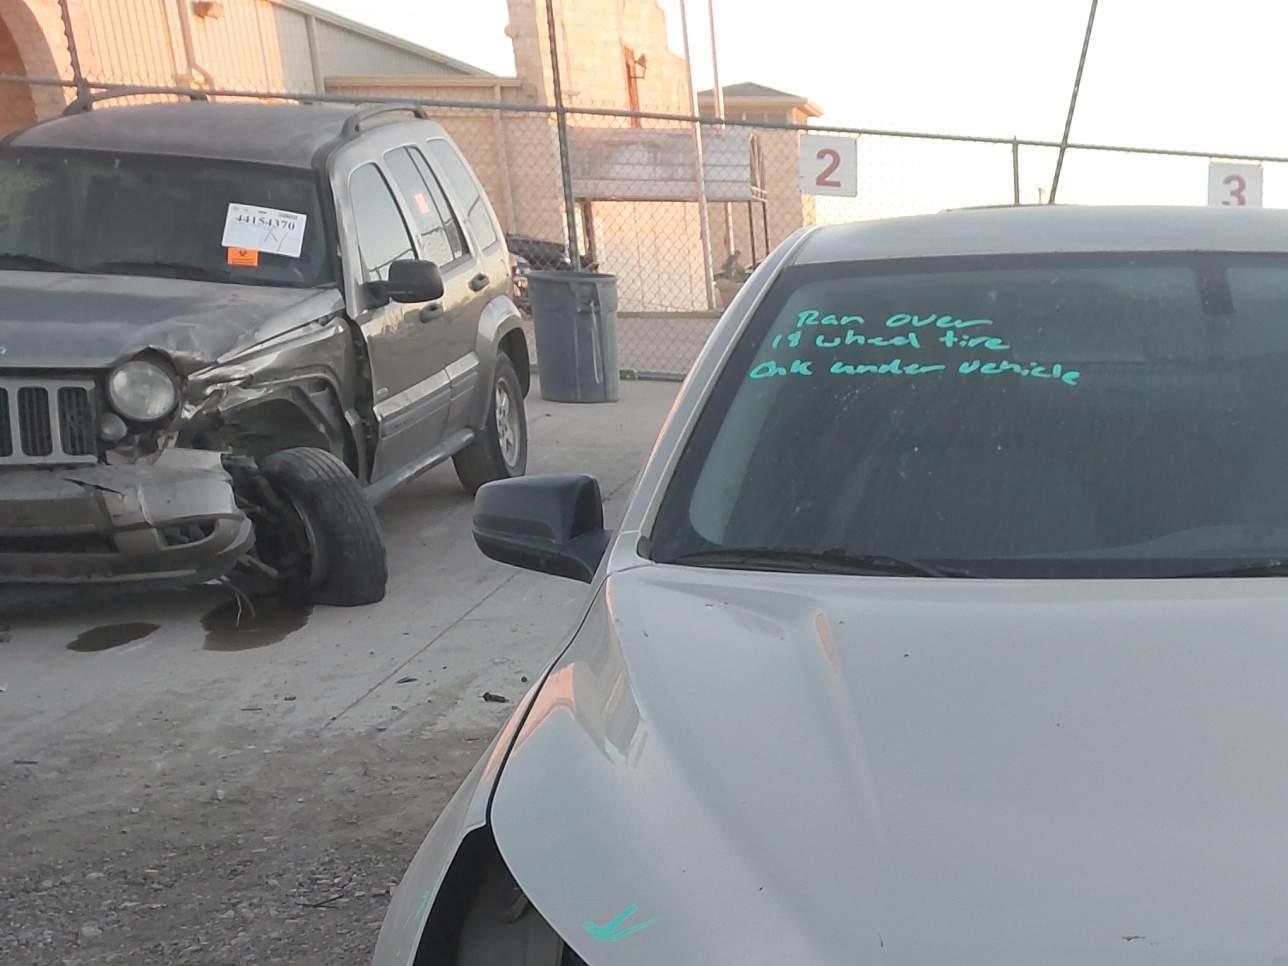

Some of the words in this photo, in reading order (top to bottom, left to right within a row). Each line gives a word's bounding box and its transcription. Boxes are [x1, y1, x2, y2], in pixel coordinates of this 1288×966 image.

[815, 147, 842, 188] 2
[1221, 173, 1247, 206] 3
[796, 310, 865, 328] Ran
[939, 328, 1010, 351] tire
